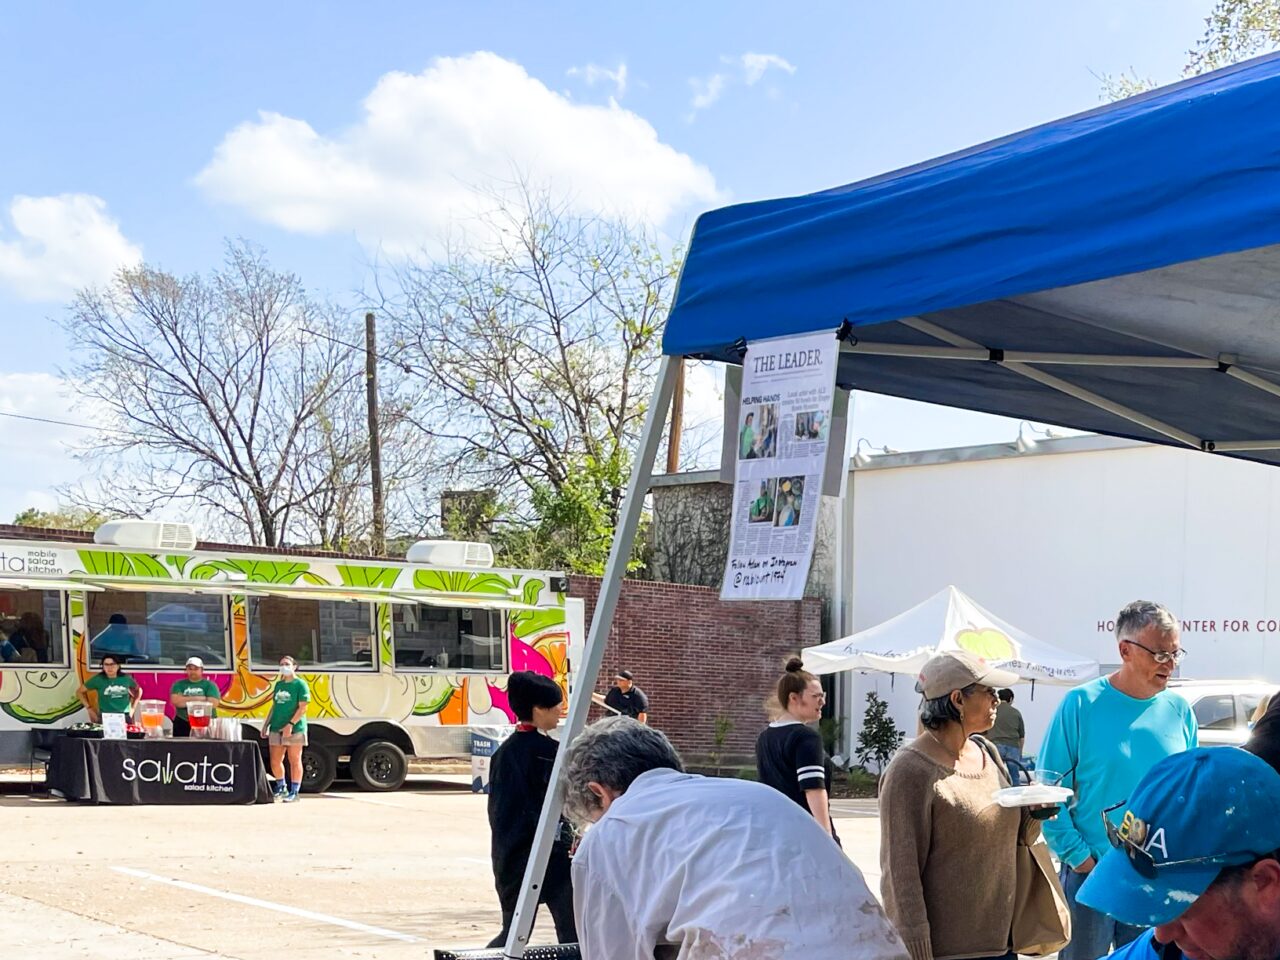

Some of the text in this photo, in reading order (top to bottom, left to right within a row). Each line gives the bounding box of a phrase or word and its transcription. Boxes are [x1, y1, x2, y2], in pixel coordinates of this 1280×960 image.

[754, 354, 776, 374] THE
[742, 396, 762, 406] HELPING
[763, 394, 781, 402] HANDS
[27, 550, 57, 558] mobile
[0, 552, 25, 572] ta
[28, 558, 56, 566] salad
[27, 565, 63, 574] kitchen
[1097, 620, 1115, 632] HO
[1180, 620, 1216, 632] NTER
[1223, 620, 1250, 632] FOR
[473, 740, 492, 748] TRASH
[121, 752, 235, 785] salata
[183, 784, 234, 793] salad kitchen
